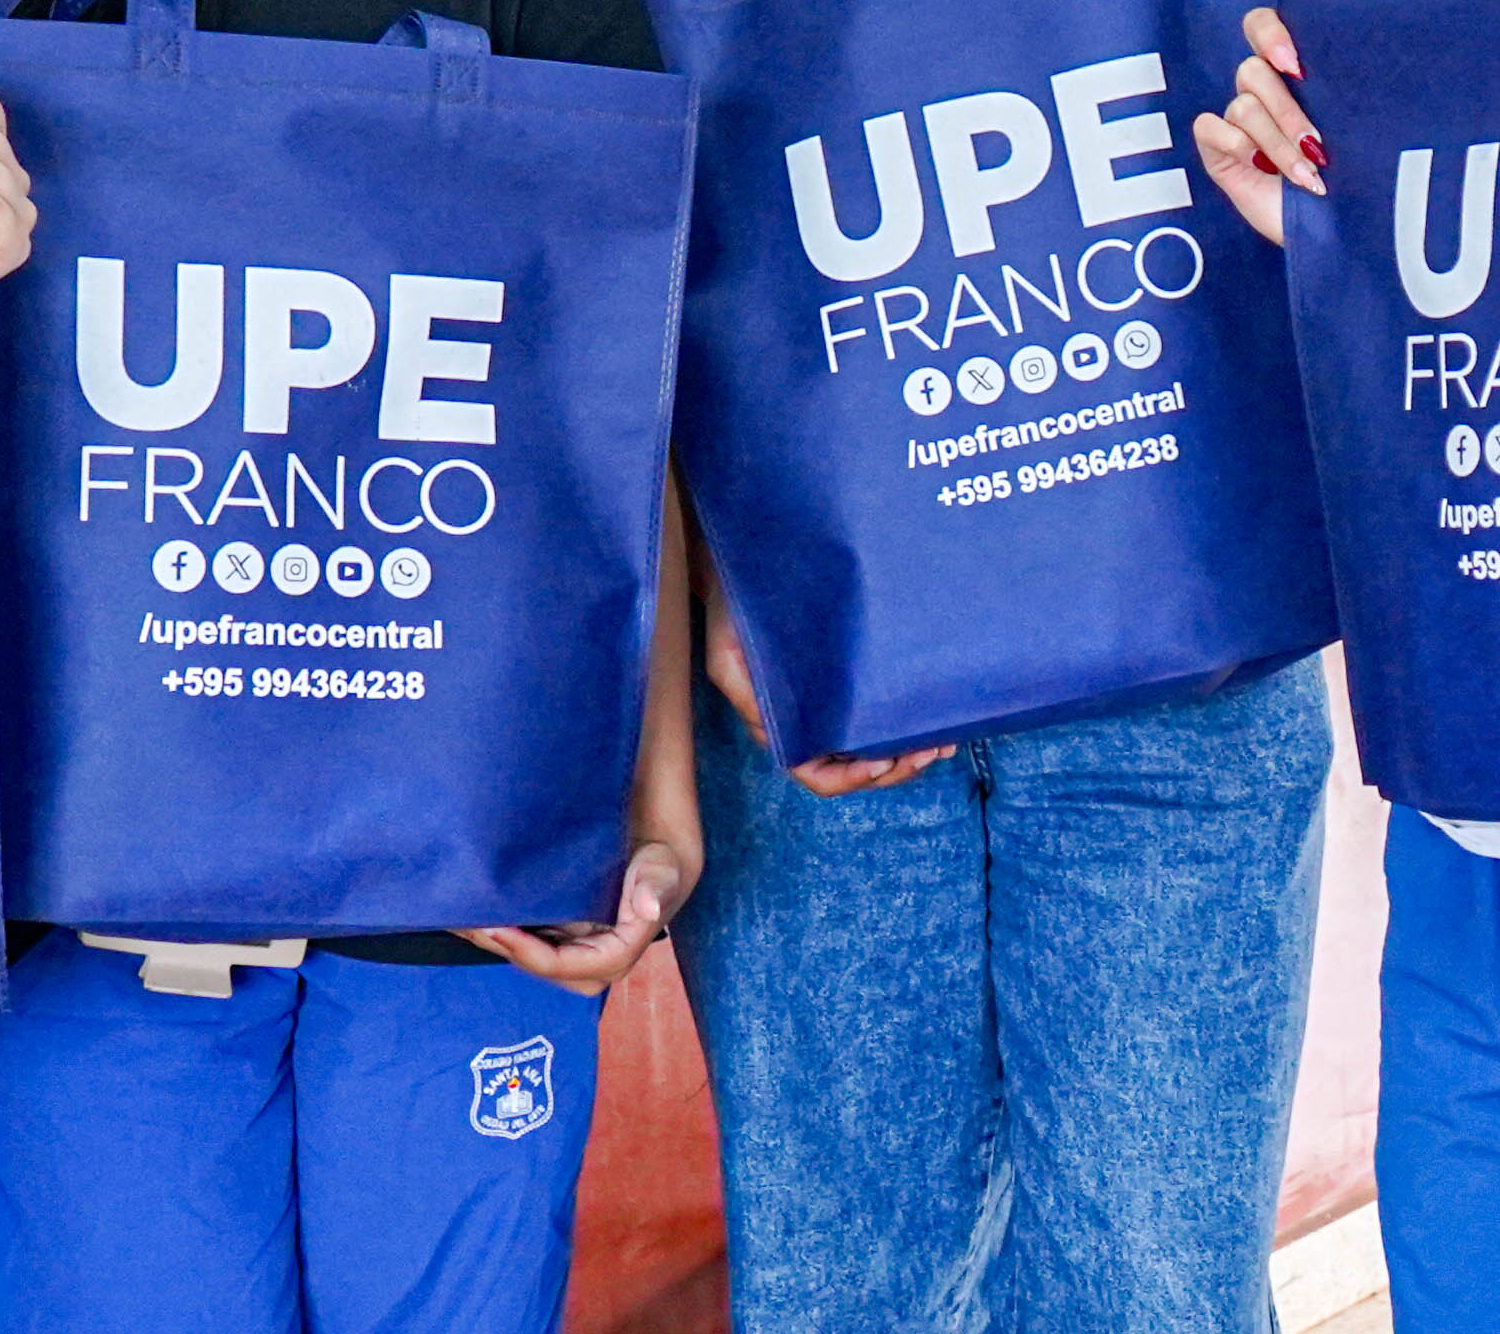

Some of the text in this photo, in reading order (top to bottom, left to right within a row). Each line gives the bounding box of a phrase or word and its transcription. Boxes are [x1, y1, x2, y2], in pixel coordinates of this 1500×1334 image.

[784, 52, 1193, 282] UPE
[820, 226, 1204, 374] FRANCO
[77, 256, 504, 445] UPE
[907, 381, 1186, 470] /upefrancocentral
[936, 433, 1180, 508] +595 994364238
[80, 445, 495, 536] FRANCO
[139, 613, 443, 651] /upefrancocentral
[161, 666, 426, 700] +595 994364238
